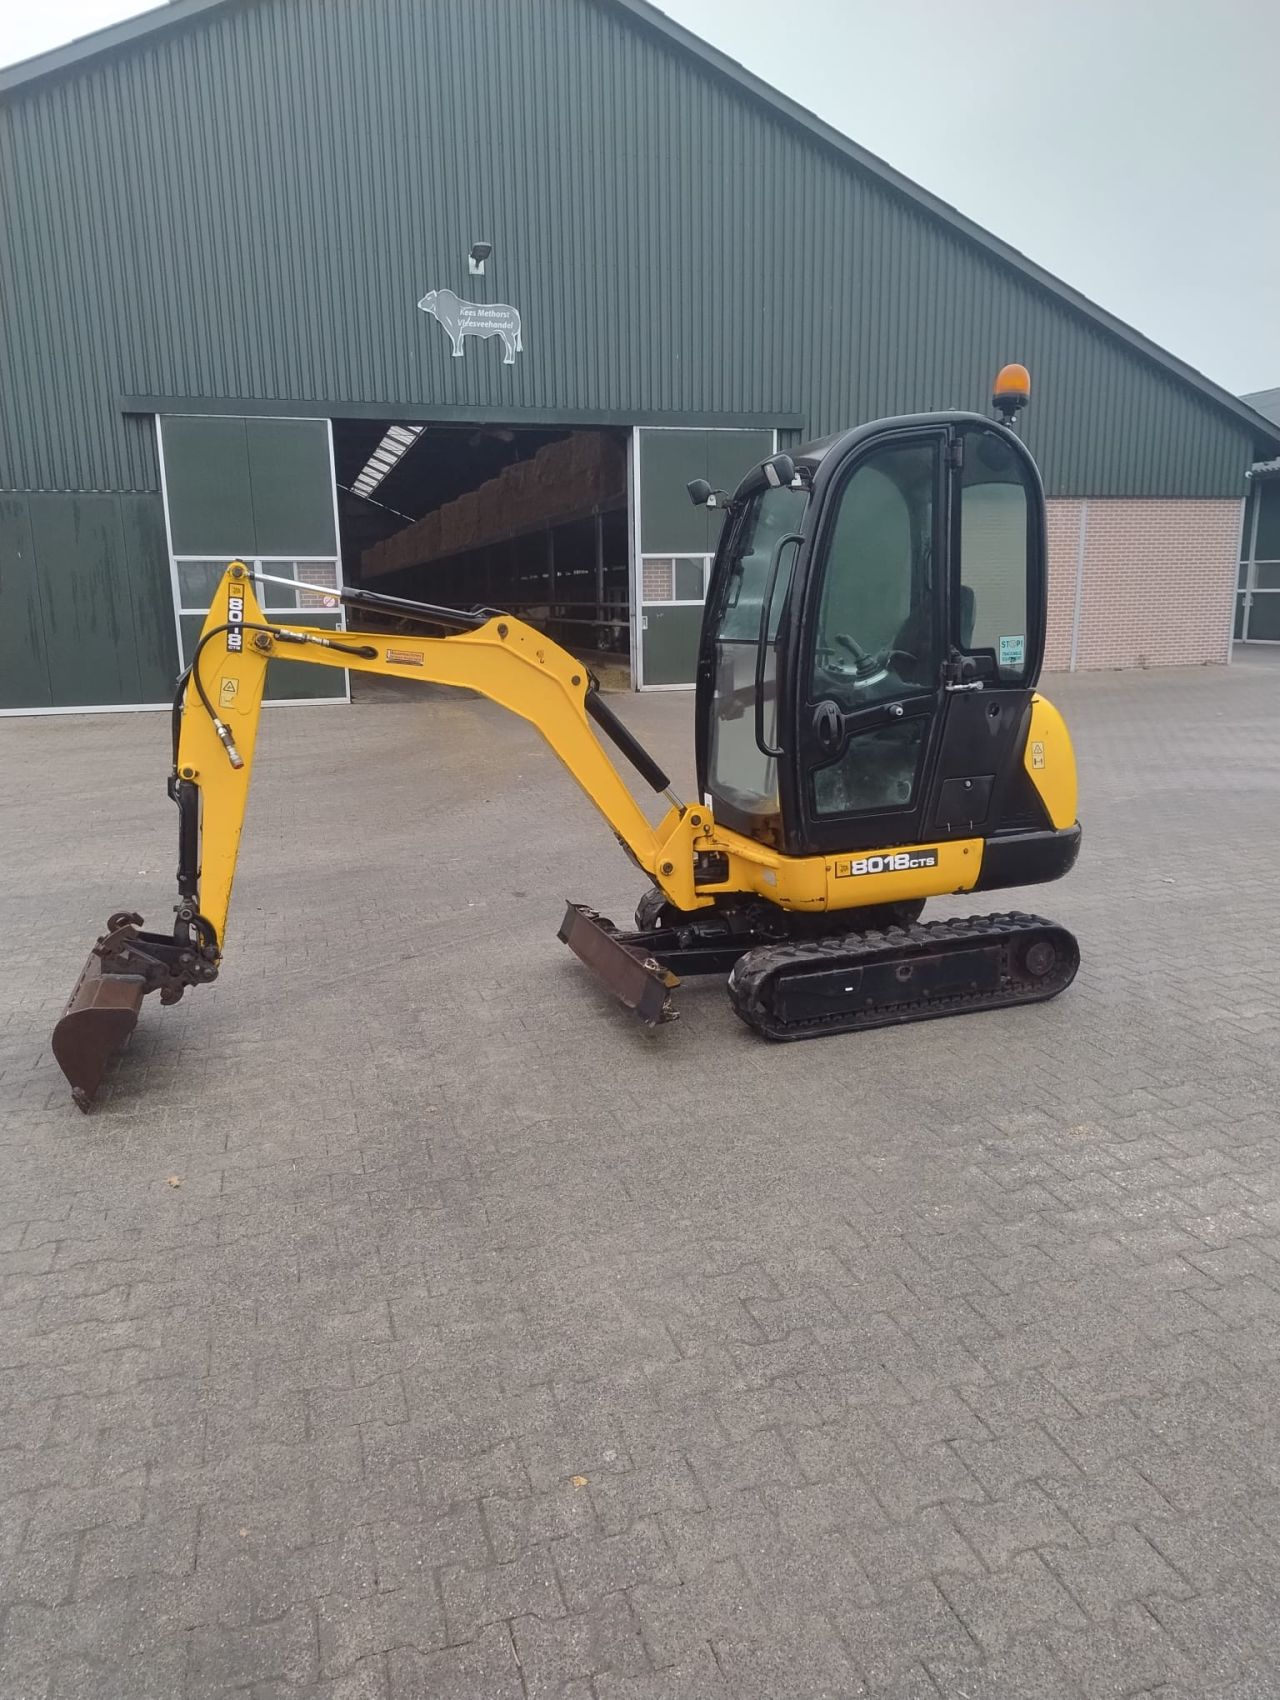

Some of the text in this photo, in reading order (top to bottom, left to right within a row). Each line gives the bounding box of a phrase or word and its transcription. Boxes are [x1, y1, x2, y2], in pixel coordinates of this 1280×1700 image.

[460, 309, 510, 318] Kees Methorst
[457, 318, 514, 329] Vleesveehandel
